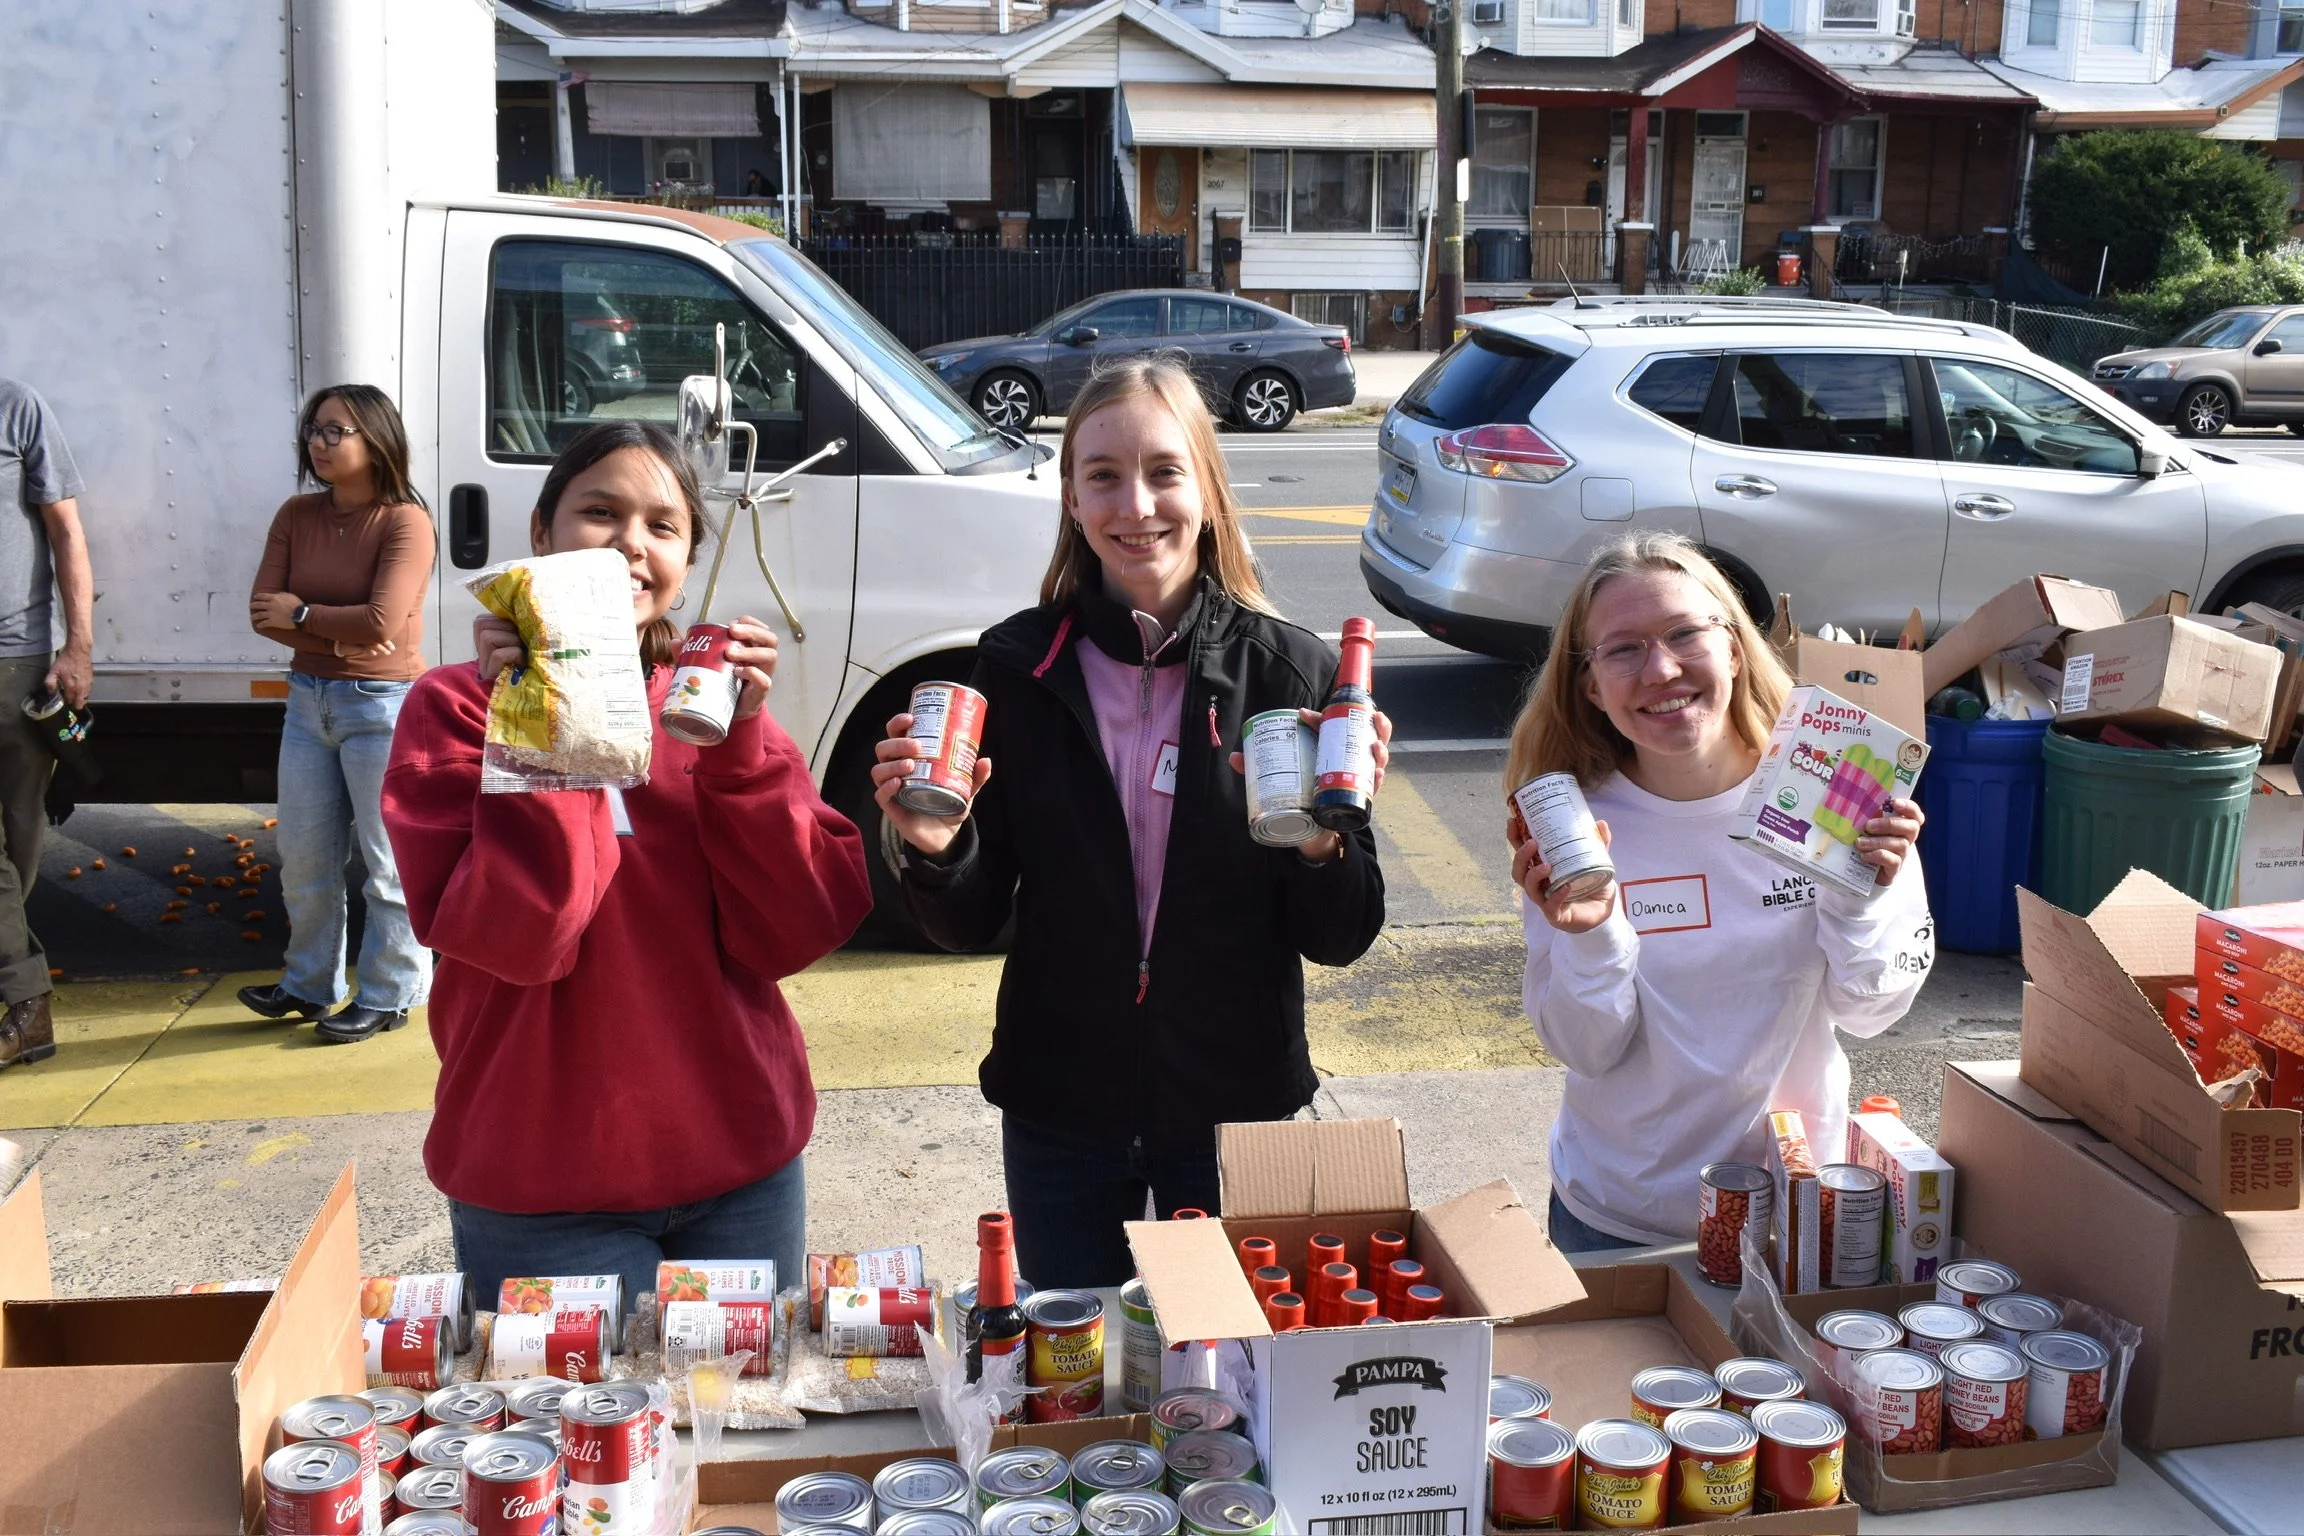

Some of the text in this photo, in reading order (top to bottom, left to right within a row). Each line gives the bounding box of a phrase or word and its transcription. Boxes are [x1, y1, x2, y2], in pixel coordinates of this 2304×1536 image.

[1815, 701, 1867, 724] Jonny
[1254, 718, 1278, 728] Nutrition
[1801, 712, 1871, 736] Pops minis
[1255, 735, 1279, 746] Calories
[1791, 750, 1834, 780] SOUR
[1522, 780, 1564, 799] Nutrition Facts
[2274, 860, 2297, 868] PAPER
[1772, 875, 1815, 892] LANC
[1762, 889, 1803, 907] BIBLE
[1632, 900, 1687, 917] Danica
[2216, 939, 2248, 955] MACARONI
[2214, 971, 2245, 988] MACARONI
[2216, 1003, 2244, 1020] MACARONI
[2180, 1015, 2204, 1033] MACARONI
[2183, 1047, 2202, 1062] ACARONI
[2230, 1132, 2247, 1194] 22015457
[2251, 1134, 2270, 1190] 270488
[2274, 1160, 2293, 1187] 404
[1898, 1173, 1907, 1230] Jonny
[894, 1250, 908, 1285] MISSION
[424, 1285, 433, 1303] PRIDE
[431, 1278, 446, 1315] MISSION
[1052, 1338, 1073, 1351] Chef
[1920, 1339, 1942, 1350] LIGHT
[1051, 1348, 1098, 1364] TOMATO
[1056, 1360, 1095, 1374] SAUCE
[1355, 1361, 1425, 1383] PAMPA
[1951, 1376, 1992, 1393] LIGHT RED
[1884, 1394, 1901, 1403] RED
[1945, 1384, 2000, 1404] KIDNEY BEANS
[1882, 1403, 1909, 1413] BEANS
[1952, 1397, 1988, 1411] LOW SODIUM
[1369, 1405, 1416, 1437] SOY
[1356, 1437, 1428, 1474] SAUCE
[1706, 1467, 1730, 1482] Chef
[1587, 1475, 1641, 1492] Chef John's
[1703, 1478, 1754, 1495] TOMATO
[1320, 1484, 1457, 1505] 12 x 10 fl oz (12 x 295mL)
[1585, 1488, 1643, 1508] TOMATO
[1710, 1491, 1751, 1506] SAUCE
[1589, 1503, 1636, 1519] SAUCE
